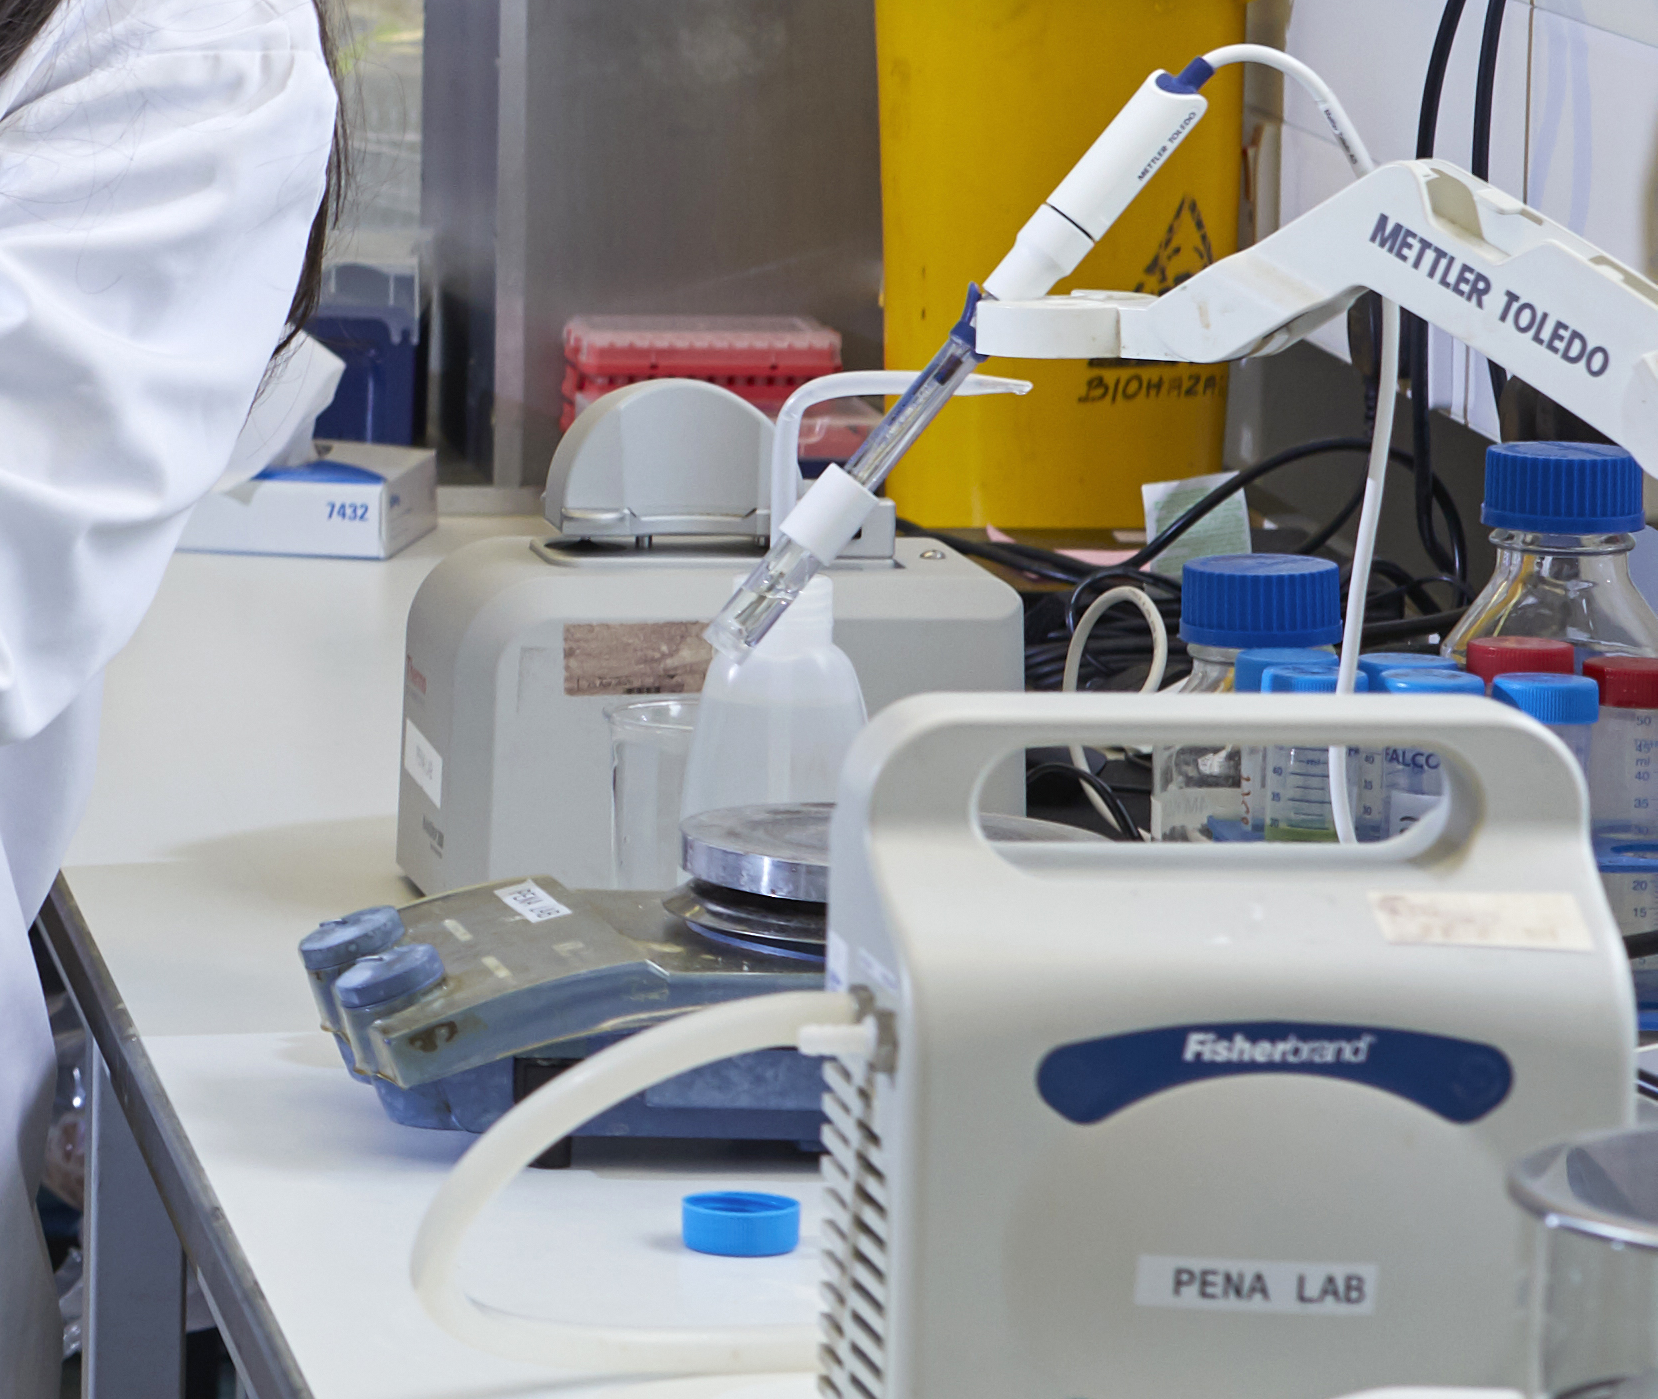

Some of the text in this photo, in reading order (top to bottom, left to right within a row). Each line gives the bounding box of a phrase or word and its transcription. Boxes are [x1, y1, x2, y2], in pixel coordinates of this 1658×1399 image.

[1137, 111, 1198, 181] METTLER TOLEDO
[1368, 212, 1610, 378] METTLER TOLEDO
[326, 500, 369, 522] 7432
[1632, 880, 1648, 892] 20
[1182, 1031, 1378, 1064] Fisherbrand
[1172, 1267, 1367, 1305] PENA LAB
